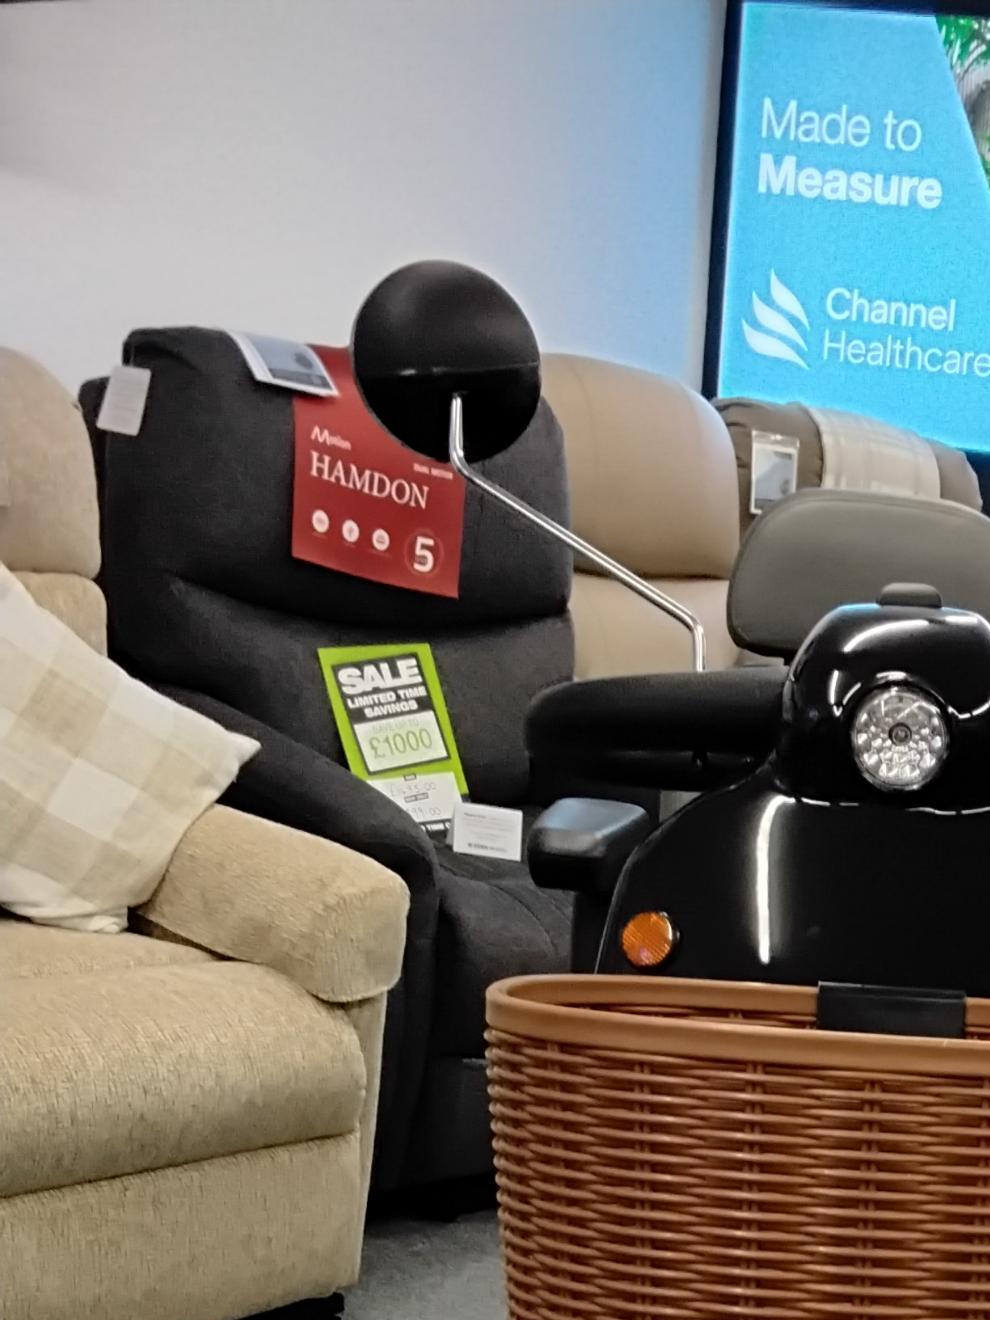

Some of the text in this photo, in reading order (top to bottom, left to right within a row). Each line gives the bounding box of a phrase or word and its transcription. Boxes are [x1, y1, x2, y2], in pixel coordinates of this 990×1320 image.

[760, 96, 922, 152] Made to
[757, 153, 943, 210] Measure
[825, 286, 956, 332] Channel
[310, 450, 429, 509] HAMDON
[413, 536, 435, 573] 5
[338, 657, 423, 695] SALE
[346, 685, 428, 709] LIMITED TIME
[363, 699, 419, 719] SAVINGS
[369, 728, 433, 760] £1000
